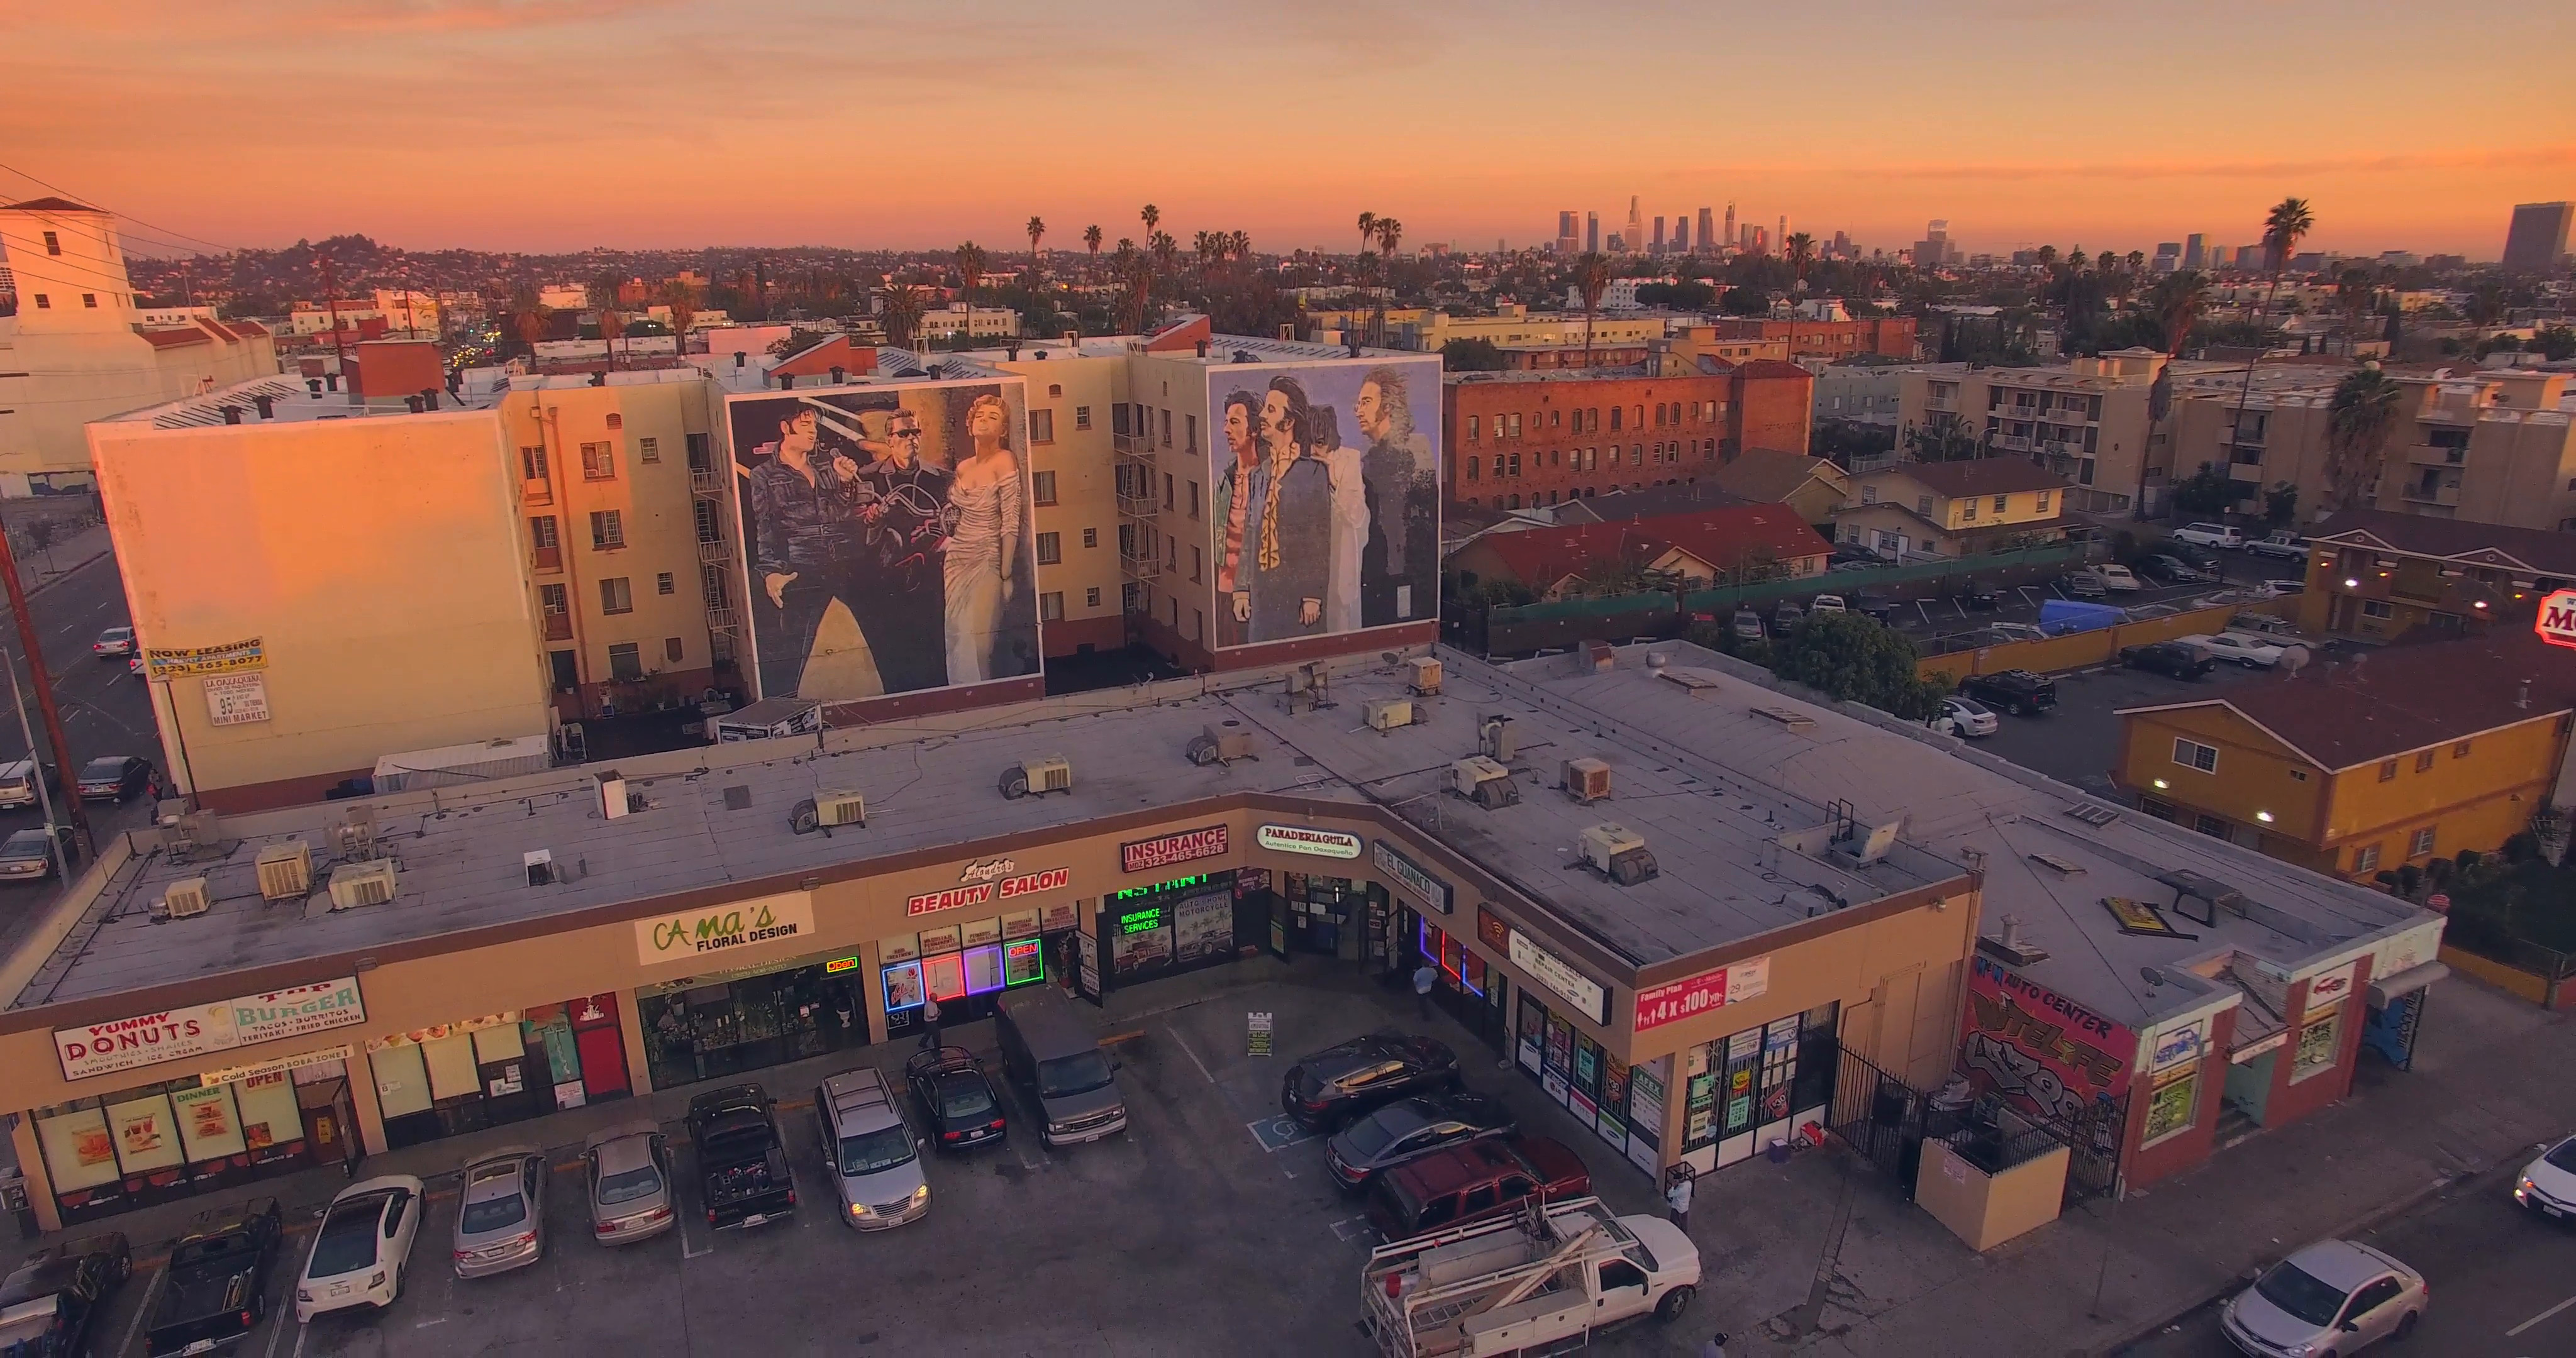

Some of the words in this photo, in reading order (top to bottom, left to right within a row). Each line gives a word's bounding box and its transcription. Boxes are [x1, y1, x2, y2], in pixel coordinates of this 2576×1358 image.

[150, 650, 189, 658] NOW
[196, 639, 261, 655] LEASING
[201, 650, 250, 662] APARTMENTS
[214, 716, 231, 724] MINI
[233, 711, 267, 722] MARKET
[1126, 829, 1226, 861] INSURANCE
[1129, 861, 1143, 870] MDZ
[1145, 844, 1224, 868] 323-465-6628
[1387, 853, 1396, 871] EL
[1397, 860, 1430, 894] GUANACO
[909, 885, 991, 915] BEAUTY
[1001, 869, 1068, 897] SALON
[1179, 900, 1199, 909] AUTO
[1208, 894, 1228, 903] HOME
[1121, 908, 1160, 924] INSURANCE
[1179, 902, 1228, 917] MOTORCYCLE
[696, 934, 746, 952] FLORAL
[750, 923, 798, 942] DESIGN
[1124, 920, 1158, 934] SERVICES
[1009, 944, 1037, 956] OPEN
[828, 958, 855, 971] Open
[1535, 958, 1553, 973] REPAIR
[1554, 971, 1575, 989] CENTER
[1640, 989, 1665, 1002] Family
[1667, 984, 1682, 995] Plan
[236, 987, 357, 1026] BURGER
[1657, 1001, 1667, 1020] 4
[2005, 971, 2040, 1000] AUTO
[2043, 993, 2112, 1039] CENTER
[89, 1012, 170, 1036] YUMMY
[243, 1029, 284, 1042] TERIYAKI
[296, 1021, 321, 1032] FRIED
[324, 1013, 361, 1026] CHICKEN
[252, 1020, 287, 1032] TACOS
[296, 1008, 348, 1024] BURRITOS
[65, 1019, 201, 1061] DONUTS
[72, 1059, 134, 1076] SANDWICH
[147, 1053, 163, 1061] ICE
[169, 1046, 203, 1057] CREAM
[84, 1049, 142, 1066] SMOOTHIES
[221, 1071, 246, 1082] Cold
[248, 1063, 284, 1076] Season
[287, 1058, 313, 1068] BOBA
[316, 1051, 341, 1063] ZONE
[246, 1071, 283, 1089] OPEN
[1638, 1074, 1660, 1095] AFEX
[177, 1087, 221, 1103] DINNER
